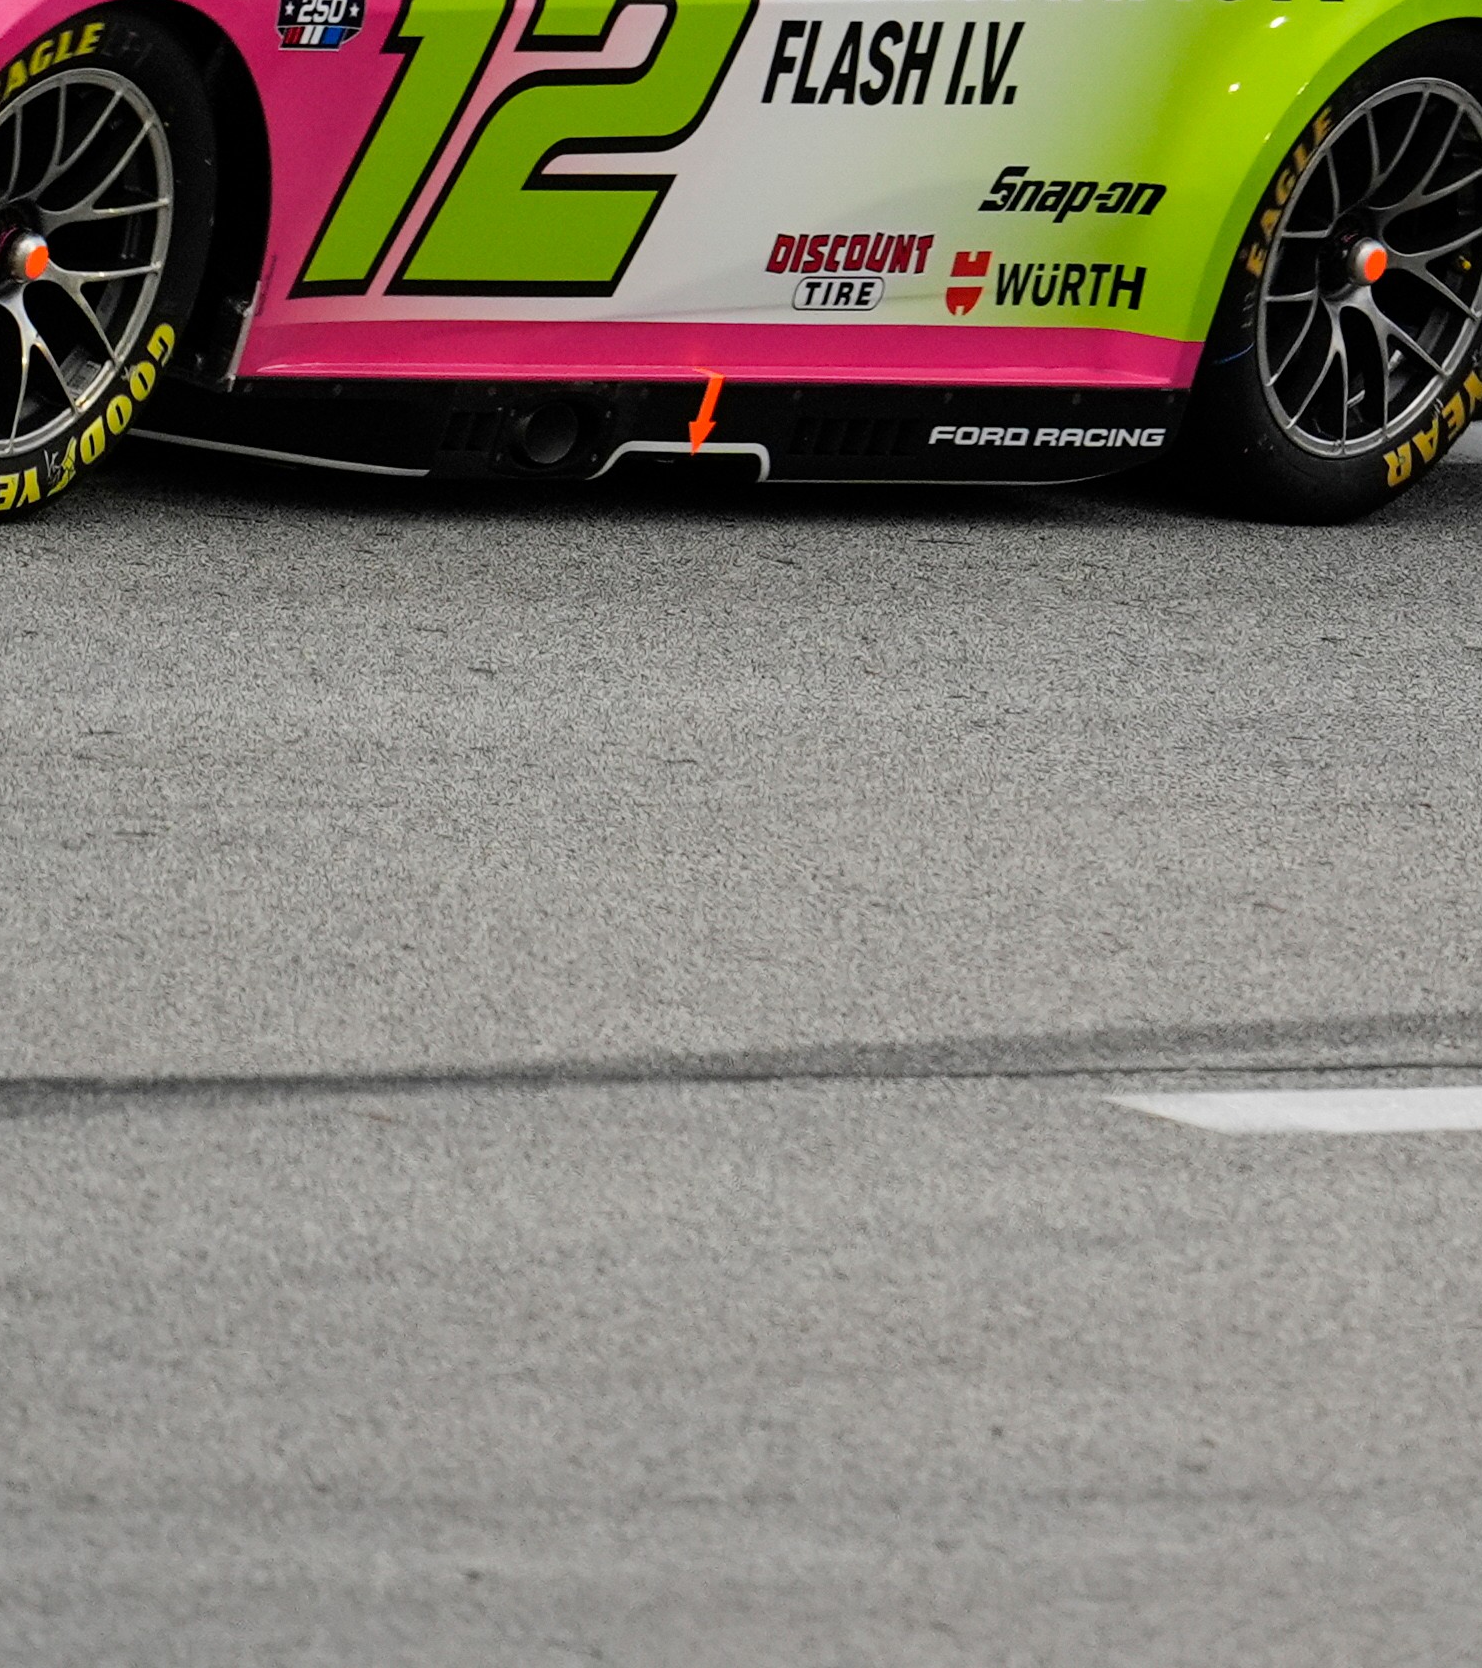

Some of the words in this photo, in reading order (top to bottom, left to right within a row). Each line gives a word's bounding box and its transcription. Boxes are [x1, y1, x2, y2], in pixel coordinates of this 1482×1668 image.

[760, 19, 945, 106] FLASH
[944, 21, 1027, 106] I.V.
[977, 165, 1168, 224] Snap-on
[1245, 105, 1333, 279] EAGLE
[765, 232, 936, 275] DISCOUNT
[804, 281, 876, 307] TIRE
[928, 425, 1030, 446] FORD
[1034, 426, 1167, 448] RACING
